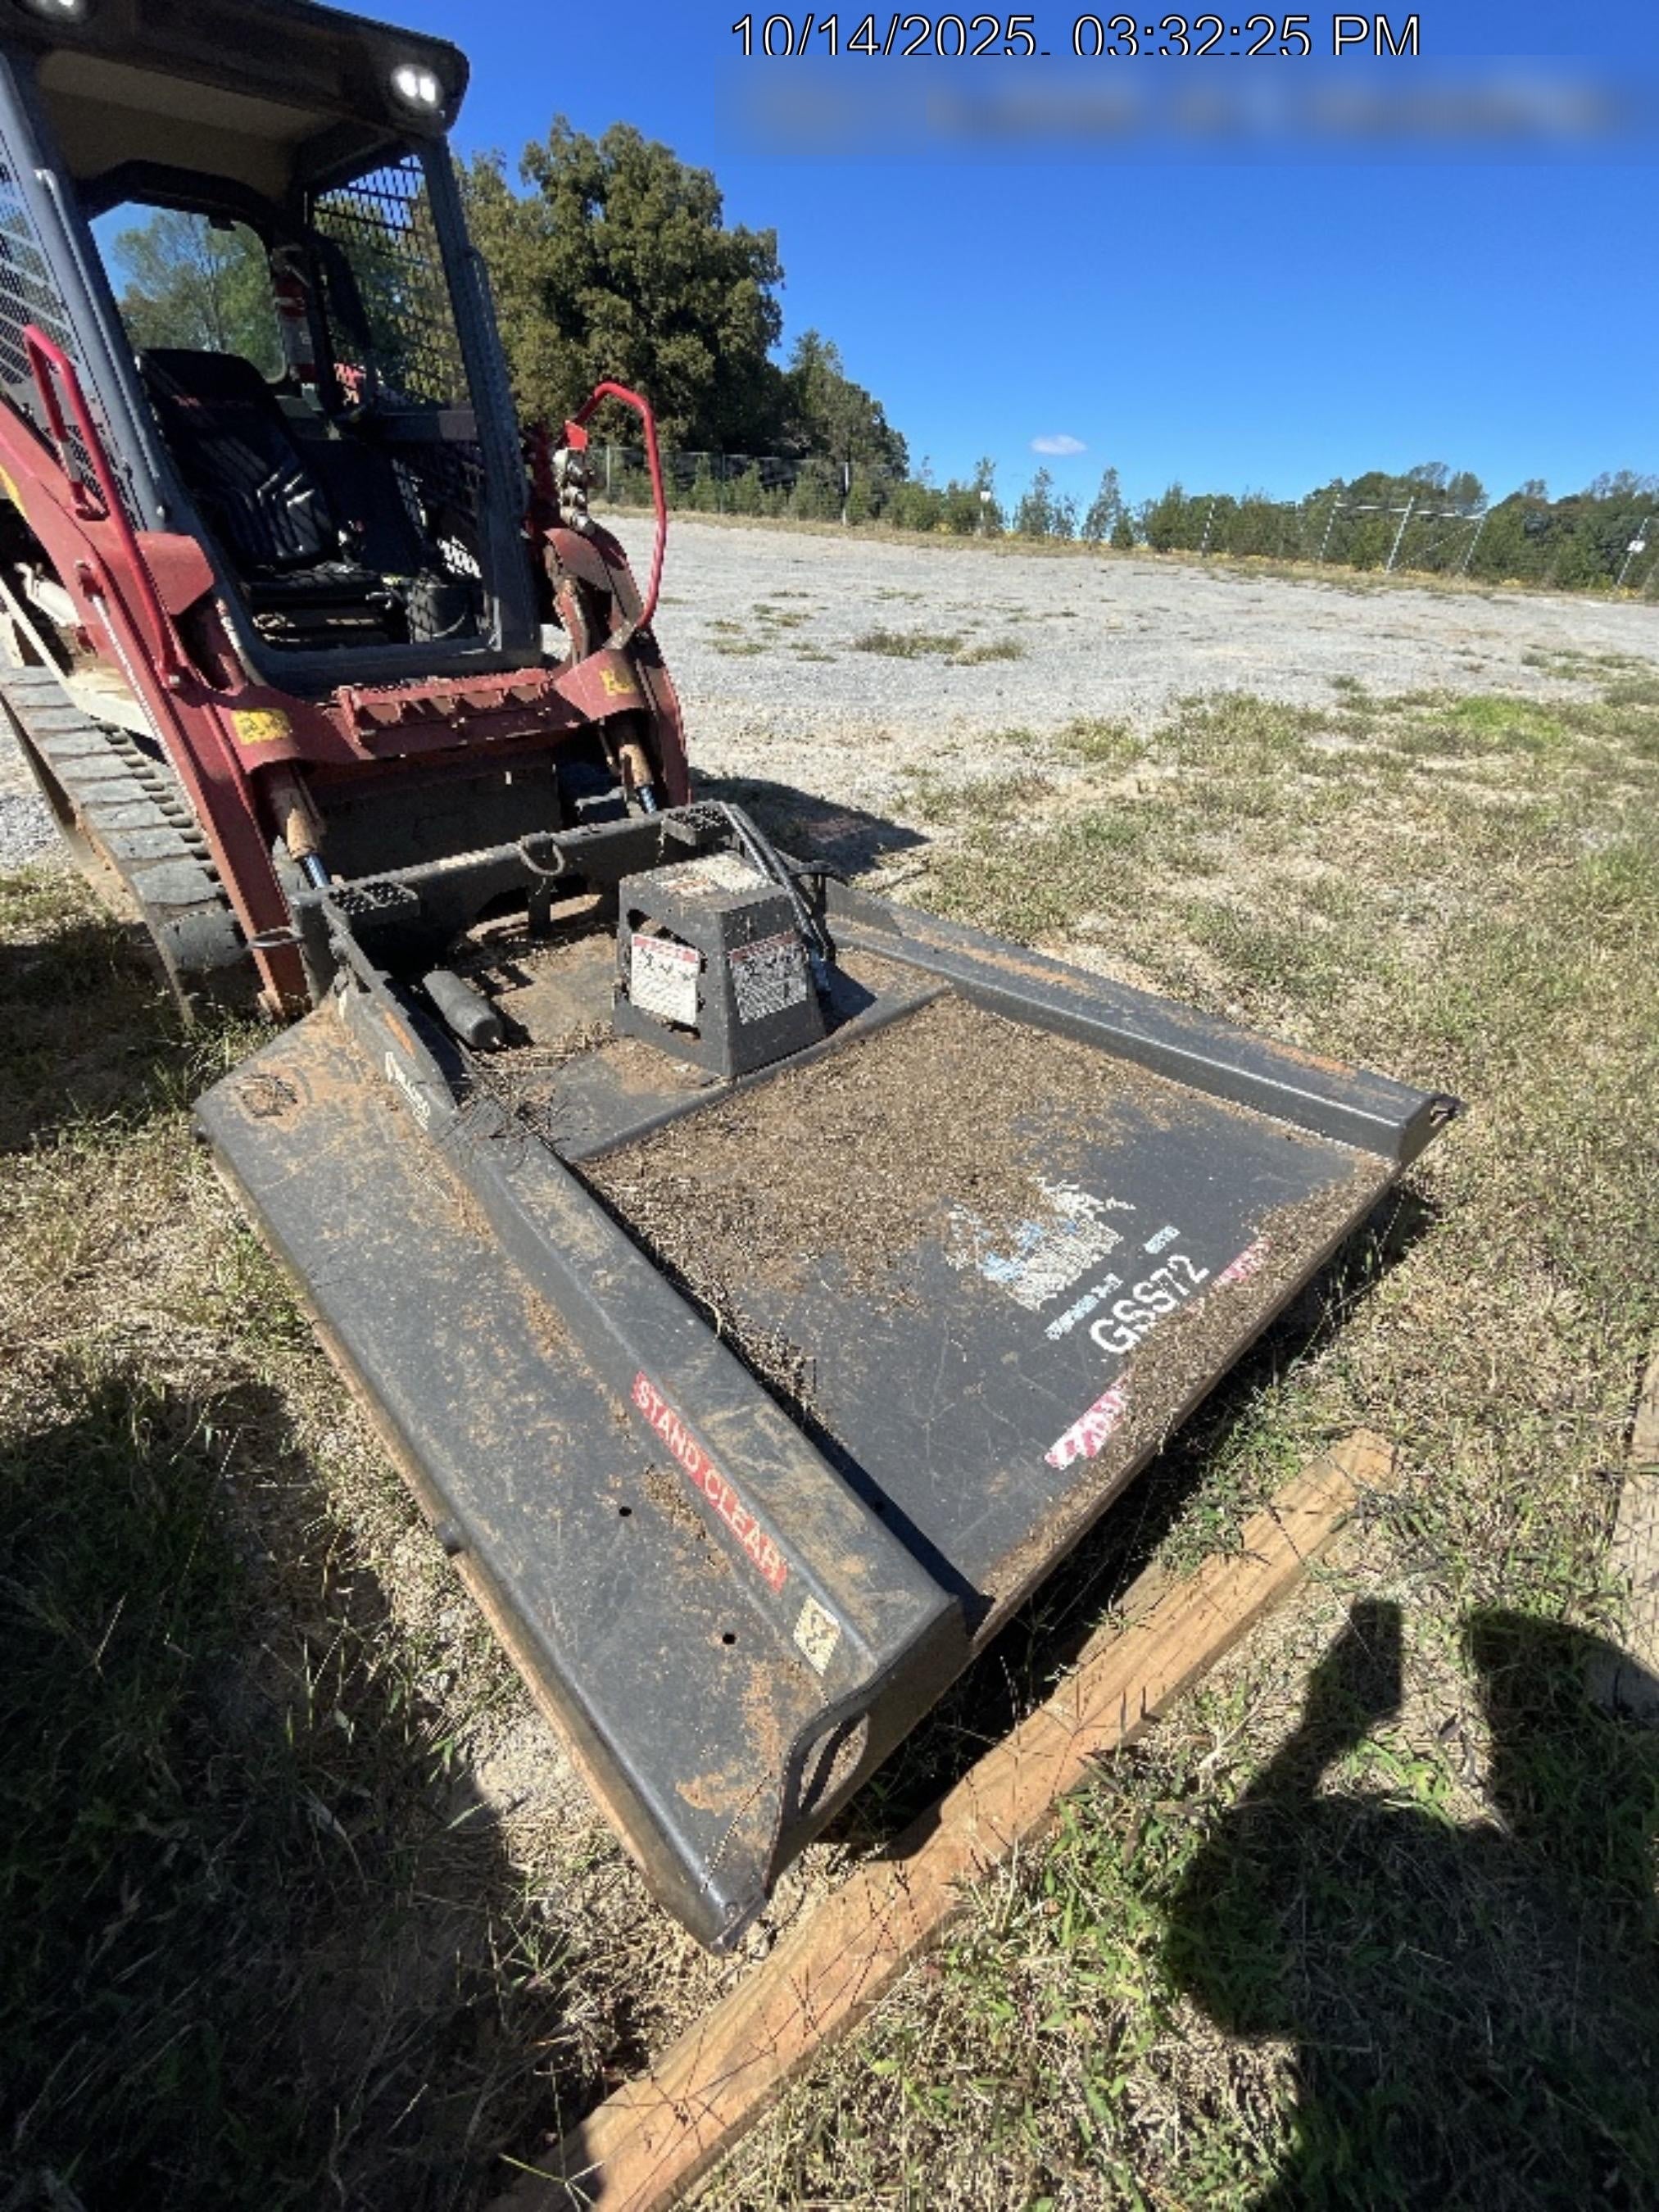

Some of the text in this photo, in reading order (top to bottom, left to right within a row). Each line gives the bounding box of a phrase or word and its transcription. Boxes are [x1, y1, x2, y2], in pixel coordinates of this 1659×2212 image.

[1090, 1255, 1209, 1354] GSS72
[636, 1380, 782, 1581] STAND CLEAR
